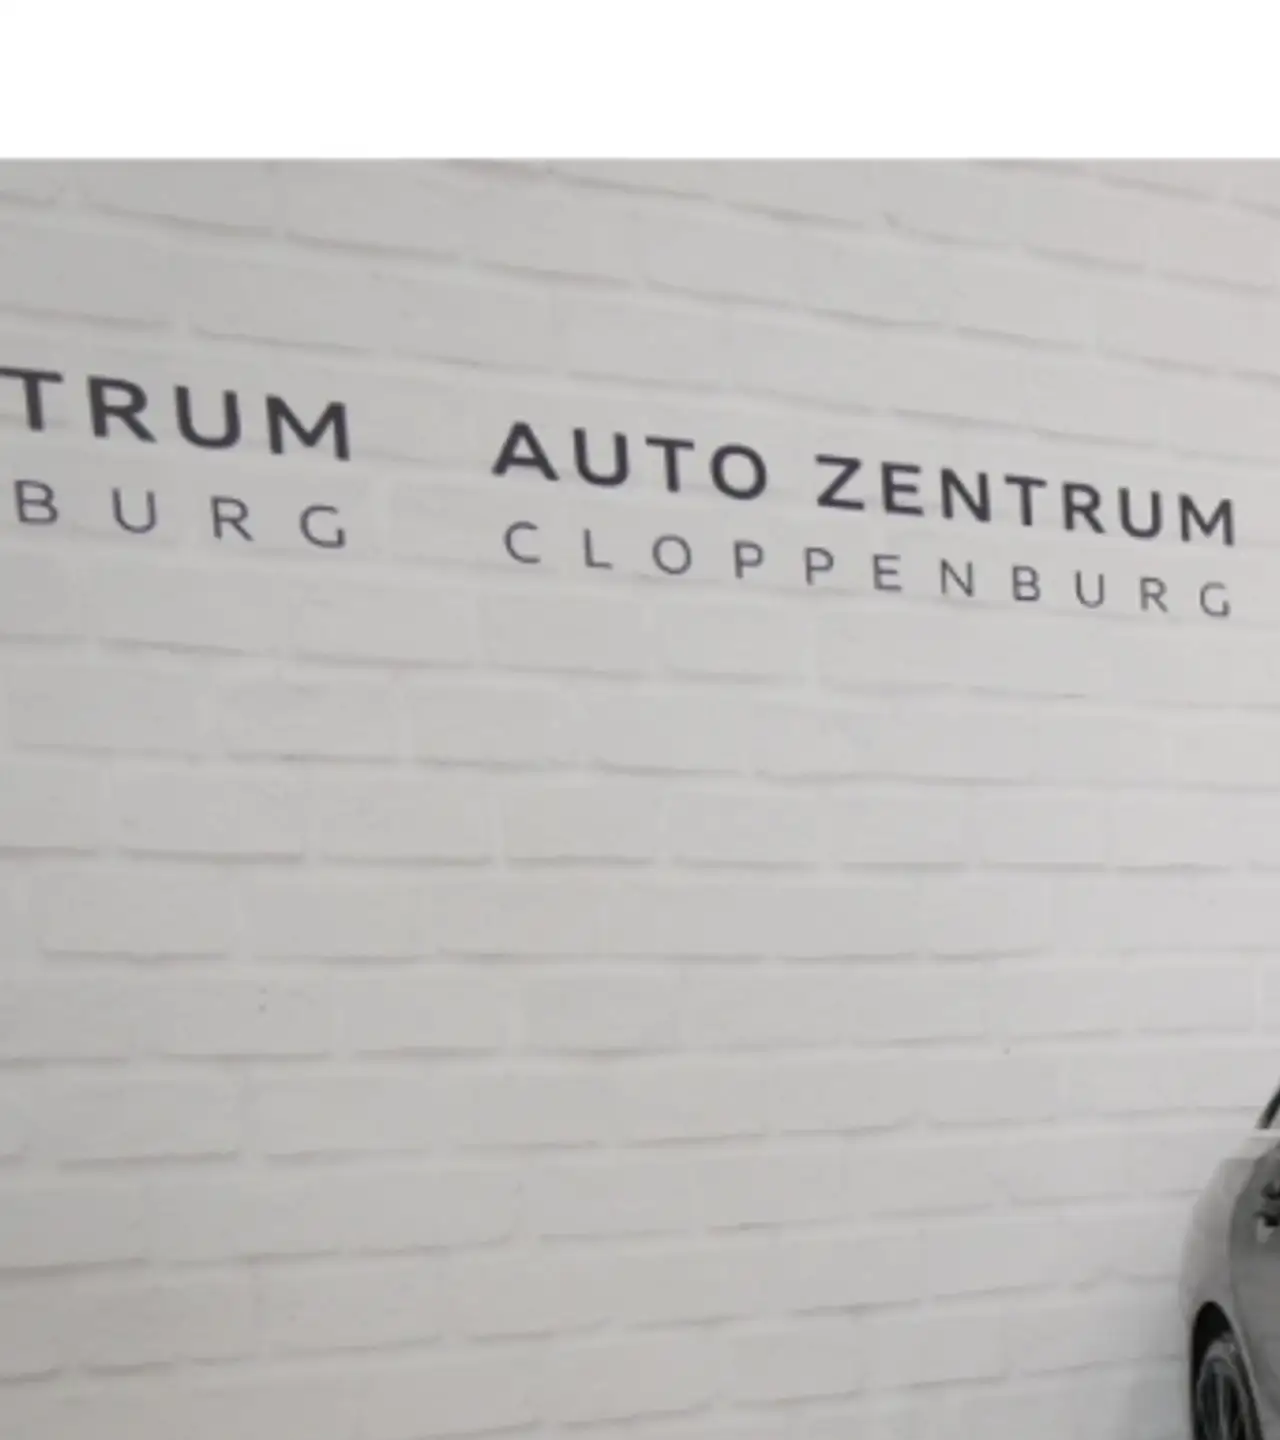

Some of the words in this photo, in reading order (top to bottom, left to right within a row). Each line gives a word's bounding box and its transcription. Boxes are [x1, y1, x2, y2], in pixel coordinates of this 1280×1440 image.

[0, 366, 350, 462] TRUM
[13, 478, 347, 550] BURG
[490, 420, 768, 502] AUTO
[813, 453, 1236, 549] ZENTRUM
[502, 520, 1232, 619] CLOPPENBURG
